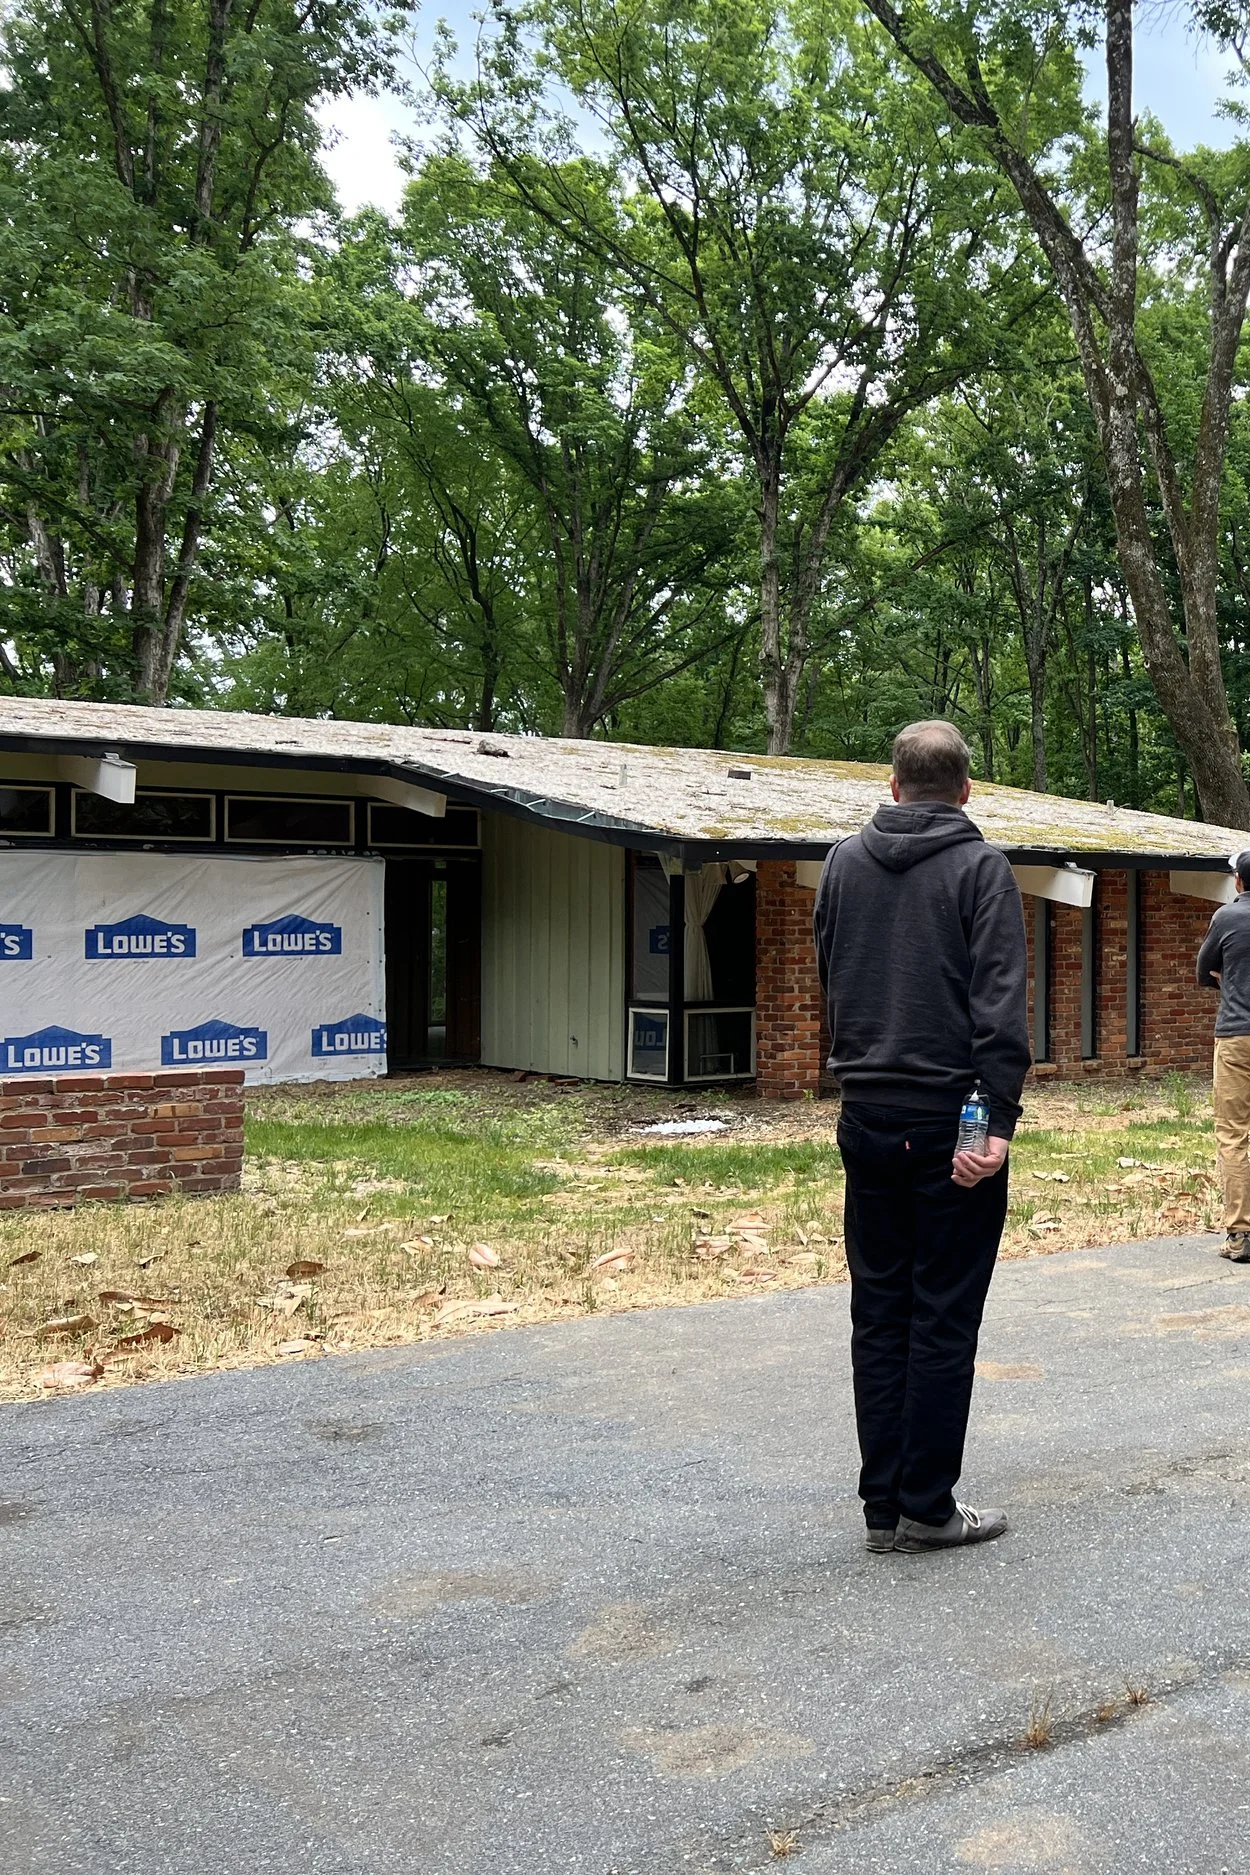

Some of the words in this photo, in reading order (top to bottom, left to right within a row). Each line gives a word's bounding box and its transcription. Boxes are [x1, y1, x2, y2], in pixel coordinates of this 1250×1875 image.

[97, 931, 185, 954] LOWE'S
[253, 930, 332, 952] LOWE'S
[173, 1035, 257, 1060] LOWE'S
[321, 1028, 387, 1052] LOWE'
[7, 1042, 100, 1068] LOWE'S
